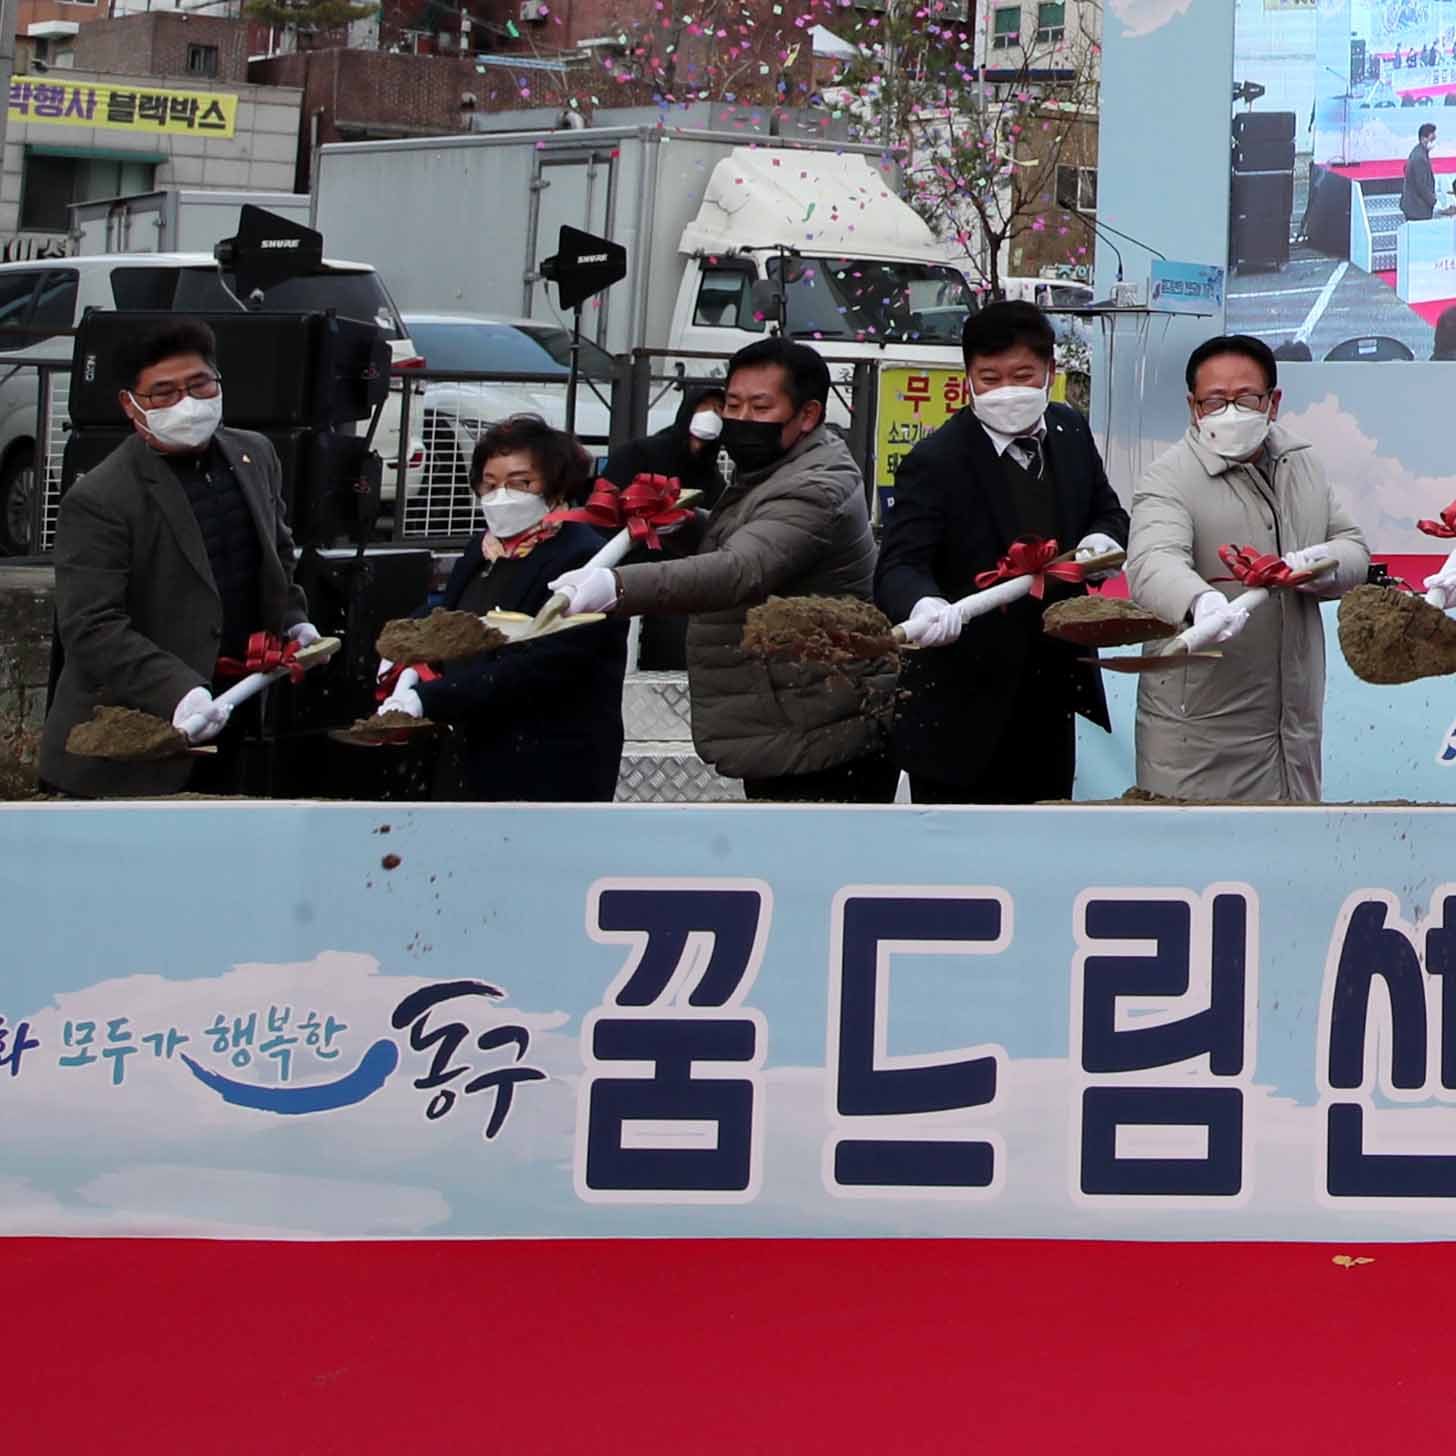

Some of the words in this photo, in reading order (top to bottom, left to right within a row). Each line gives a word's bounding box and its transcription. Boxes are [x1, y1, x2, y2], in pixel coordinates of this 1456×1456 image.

[107, 91, 227, 130] 블랙박스
[260, 239, 300, 249] SHURE
[59, 1016, 190, 1085] 모두가
[210, 1010, 347, 1080] 행복한
[391, 979, 546, 1139] 동구
